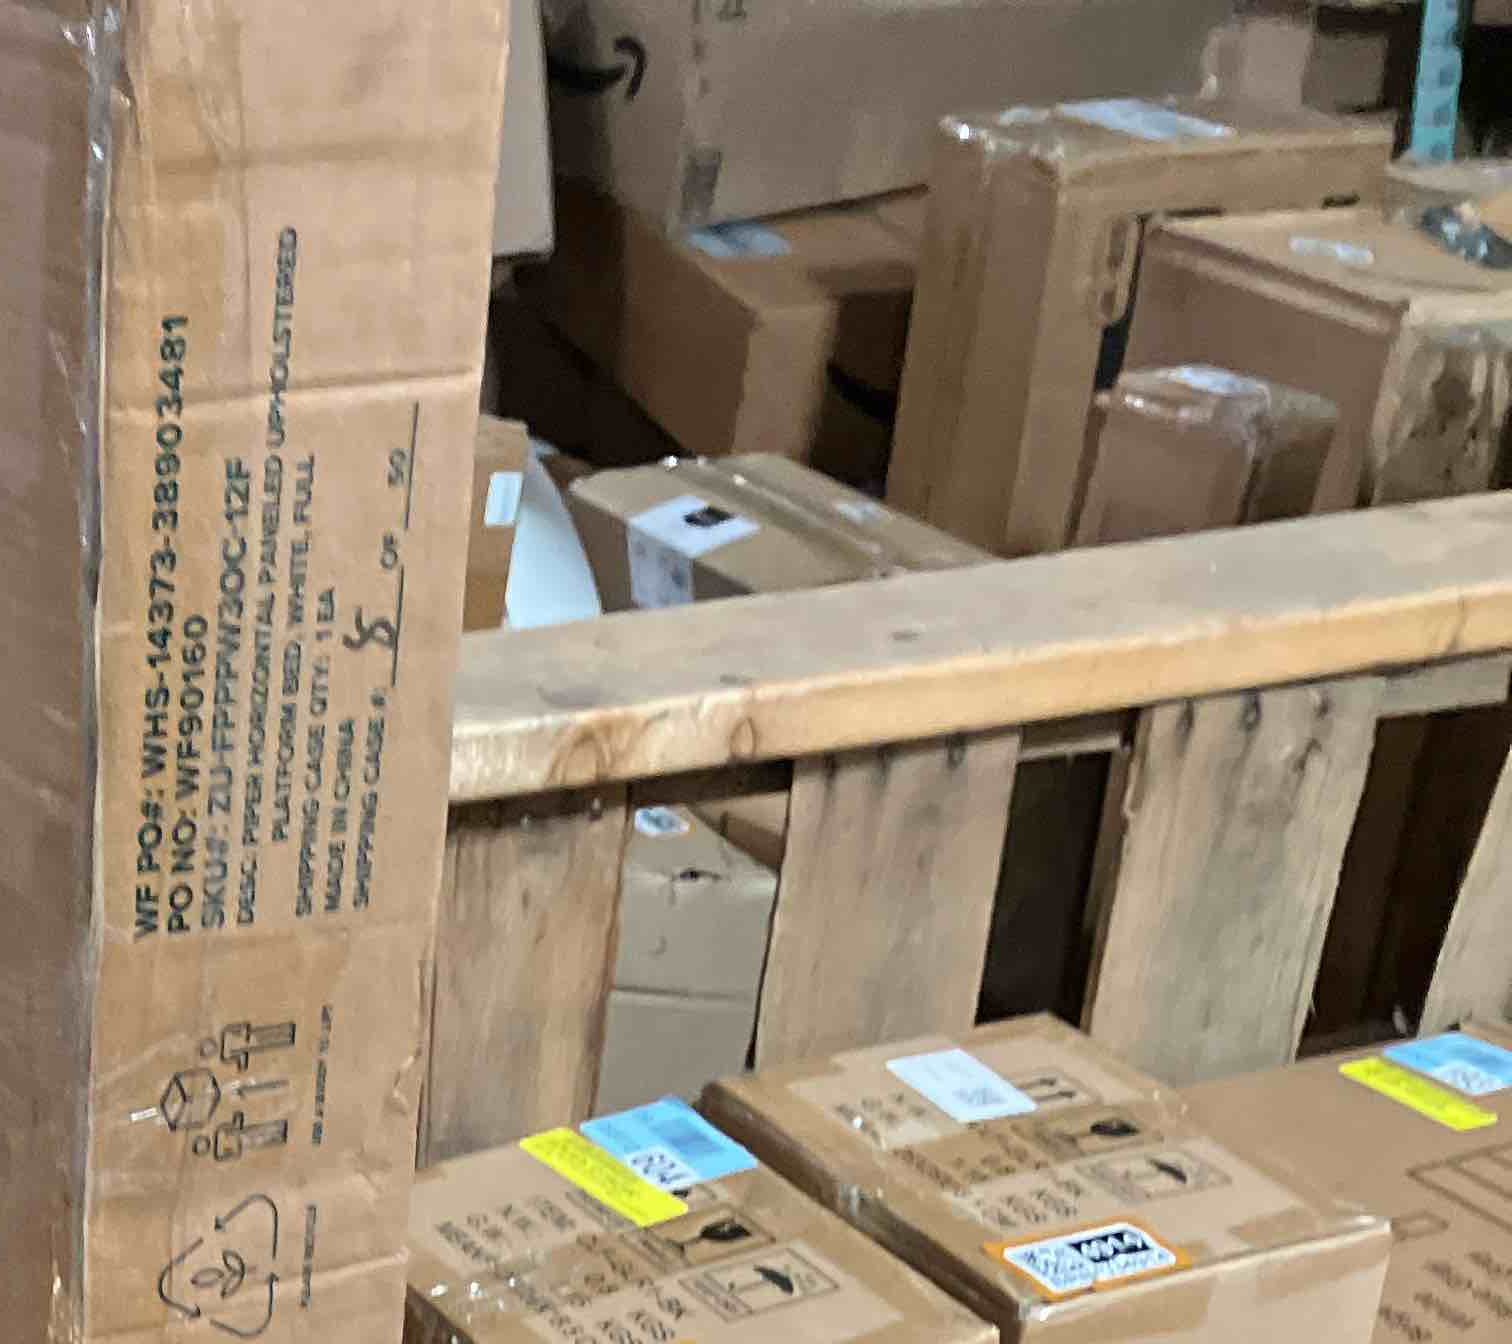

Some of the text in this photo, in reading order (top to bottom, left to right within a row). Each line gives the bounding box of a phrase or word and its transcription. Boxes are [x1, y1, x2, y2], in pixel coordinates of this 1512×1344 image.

[175, 614, 208, 801] WF90160
[135, 885, 160, 940] WF
[167, 884, 193, 936] PO
